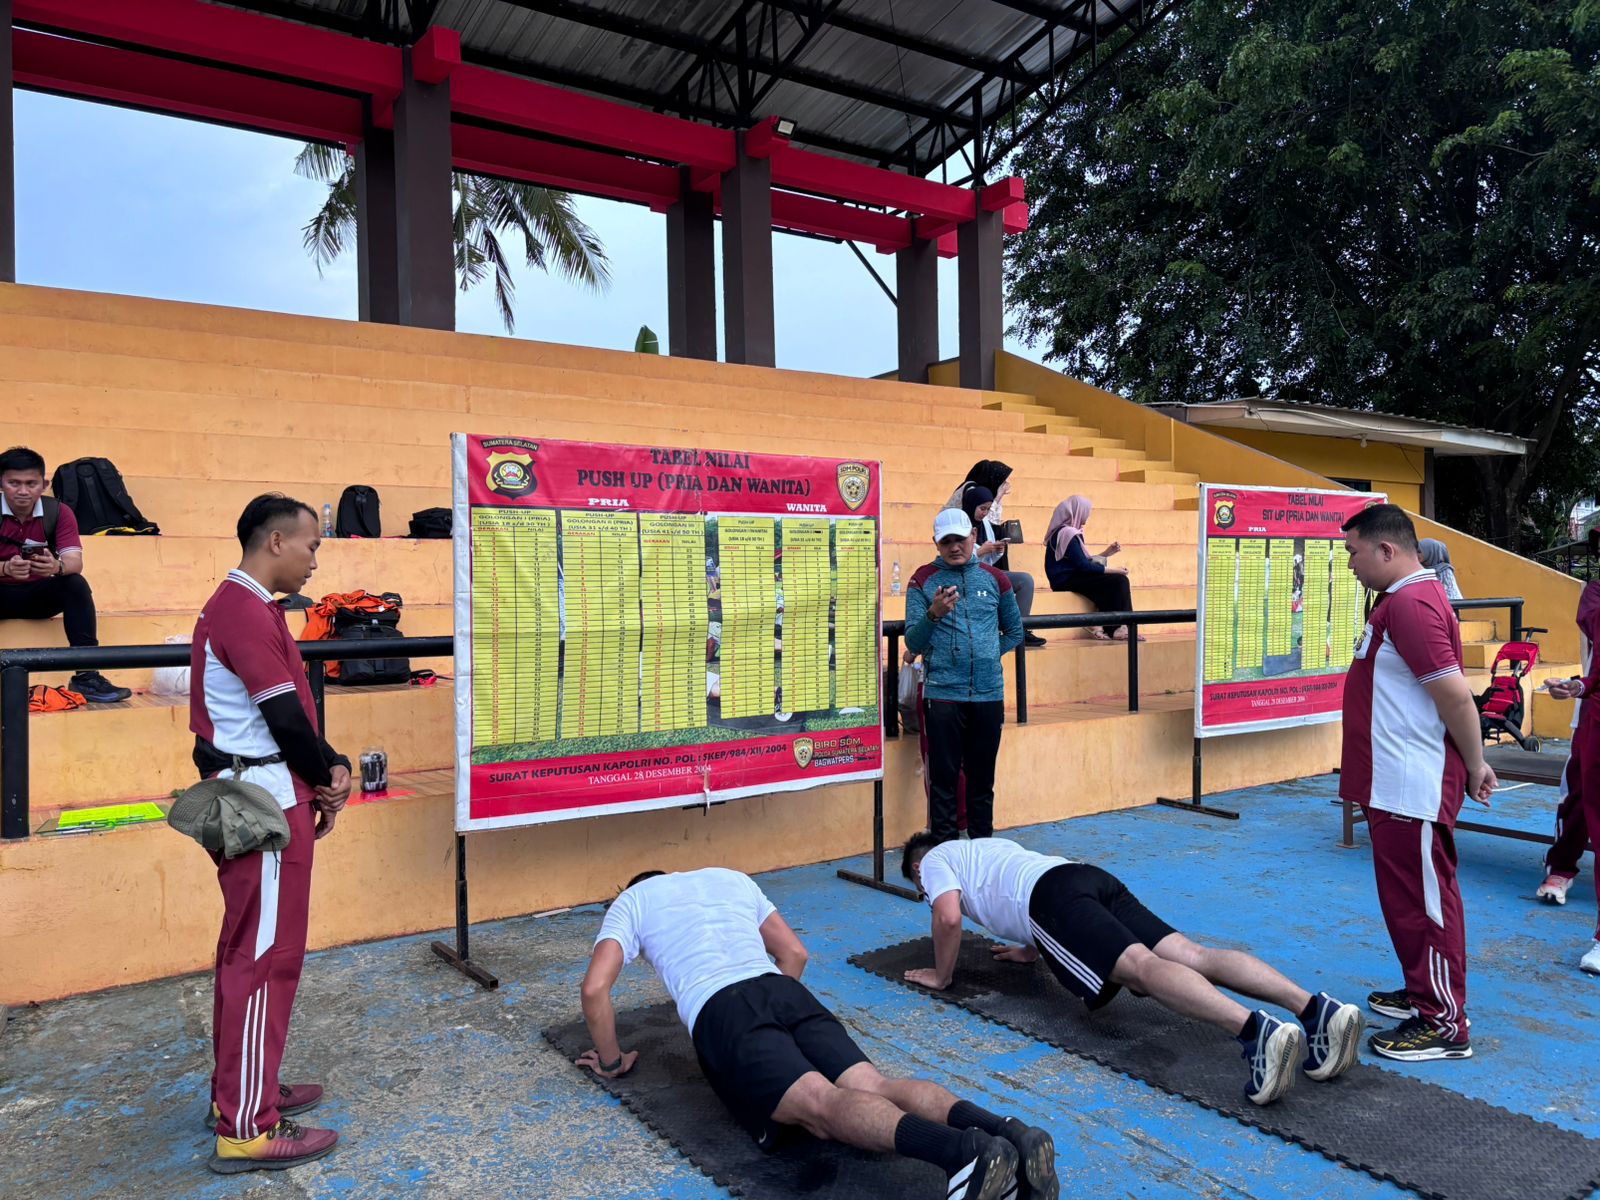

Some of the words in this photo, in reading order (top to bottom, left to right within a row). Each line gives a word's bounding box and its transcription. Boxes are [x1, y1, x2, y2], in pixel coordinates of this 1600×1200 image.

[482, 439, 512, 448] SUMATERA
[513, 440, 538, 450] SELATAN
[650, 448, 702, 466] TABEL
[705, 452, 750, 469] NILAI
[577, 470, 626, 487] PUSH
[631, 472, 654, 488] UP
[658, 472, 704, 491] (PRIA
[707, 478, 742, 493] DAN
[745, 480, 810, 496] WANITA)
[588, 498, 630, 506] PRIA
[1288, 494, 1306, 505] TABEL
[786, 503, 828, 512] WANITA
[1262, 509, 1274, 520] SIT
[1275, 510, 1284, 521] UP
[1286, 510, 1304, 523] (PRIA
[1306, 511, 1318, 522] DAN
[1320, 512, 1344, 524] WANITA)
[840, 738, 860, 746] SDM
[489, 771, 528, 784] SURAT
[532, 764, 601, 778] KEPUTUSAN
[603, 759, 652, 771] KAPOLRI
[654, 757, 672, 767] NO.
[675, 754, 696, 764] POL
[703, 744, 788, 761] SKEP/984/XII/2004
[814, 756, 854, 767] BAGWATPERS
[588, 772, 632, 785] TANGGAL
[634, 771, 644, 780] 28
[646, 766, 692, 780] DESEMBER
[693, 765, 712, 775] 2004
